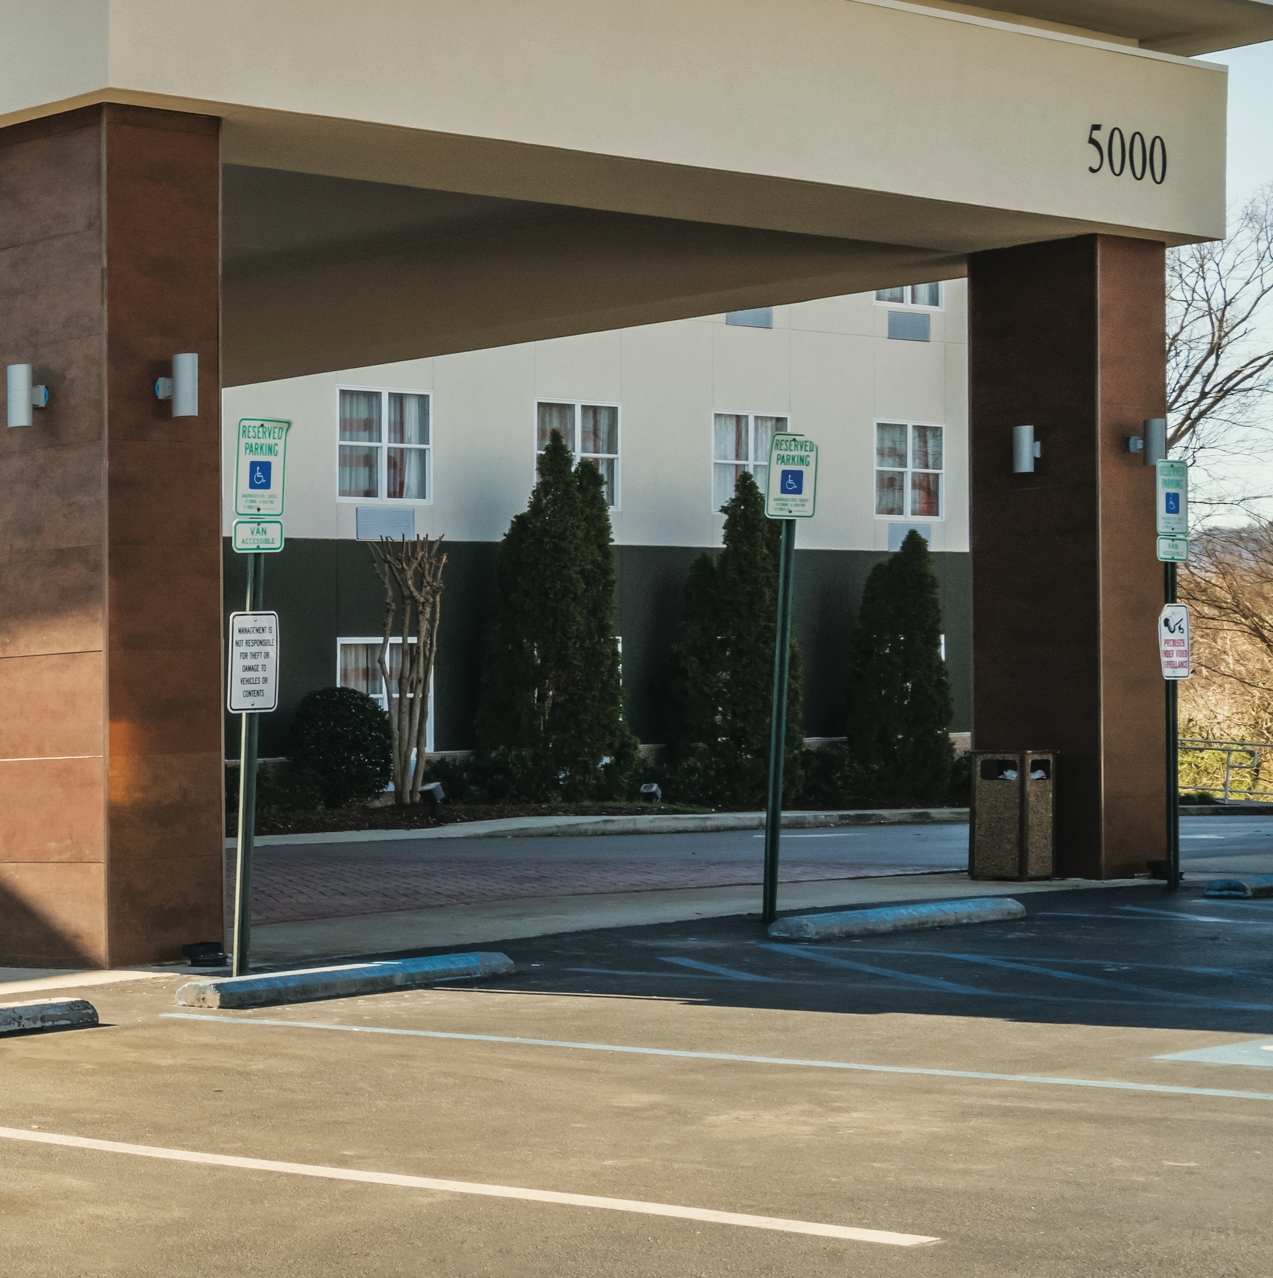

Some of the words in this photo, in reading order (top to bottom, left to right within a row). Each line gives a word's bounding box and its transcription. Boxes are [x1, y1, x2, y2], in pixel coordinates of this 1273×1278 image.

[1087, 124, 1167, 185] 5000
[241, 424, 284, 440] RESERVED
[244, 442, 279, 457] PARKING
[774, 438, 815, 452] RESERVED
[776, 453, 810, 466] PARKING
[250, 526, 267, 536] VAN
[241, 537, 275, 545] ACCESSIBLE
[237, 626, 267, 635] MANAGEMENT
[268, 626, 273, 634] IS
[235, 640, 244, 648] NOT
[245, 639, 275, 648] RESPONSIBLE
[1164, 639, 1185, 648] PREMISES
[239, 652, 248, 660] FOR
[249, 652, 263, 660] THEFT
[242, 664, 259, 673] DAMAGE
[261, 664, 267, 672] TO
[240, 677, 261, 685] VEHICLES
[242, 690, 265, 698] CONTENTS
